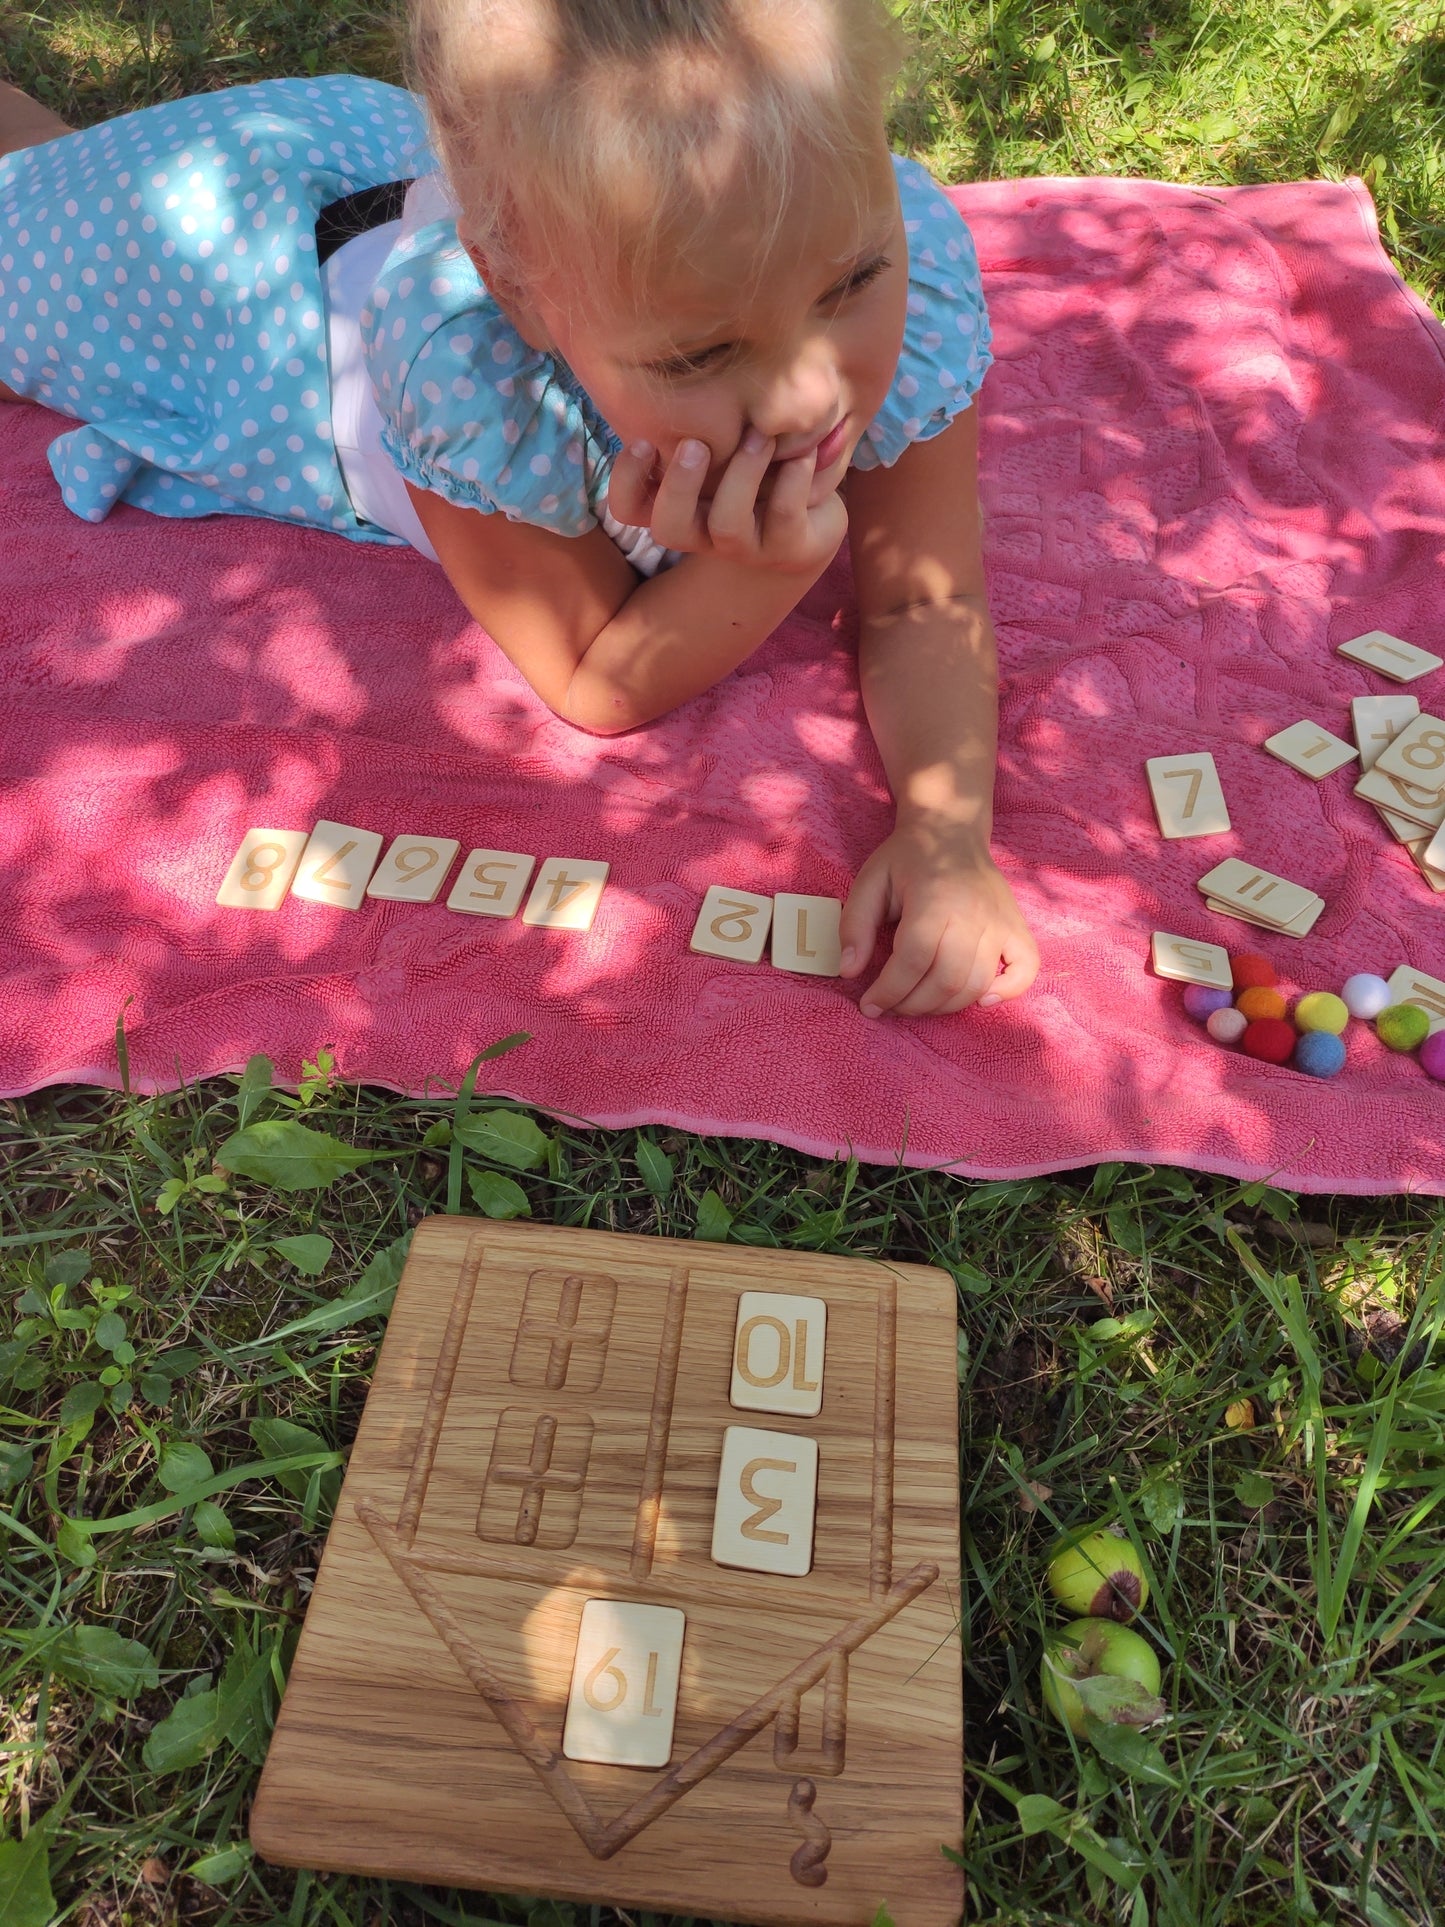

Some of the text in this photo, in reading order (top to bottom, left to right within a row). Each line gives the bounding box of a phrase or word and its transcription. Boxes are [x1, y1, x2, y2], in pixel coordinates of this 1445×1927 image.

[1401, 729, 1445, 770] 8
[1162, 768, 1203, 819] 7
[239, 842, 287, 892] 8
[311, 840, 359, 890] 7
[394, 846, 440, 883] 6
[468, 861, 518, 901] 5
[546, 870, 592, 912] 4
[709, 898, 760, 943] 2
[796, 908, 817, 958] 1
[1170, 942, 1213, 972] 5
[736, 1314, 819, 1392] 10
[739, 1457, 797, 1546] 3
[583, 1647, 664, 1718] 19
